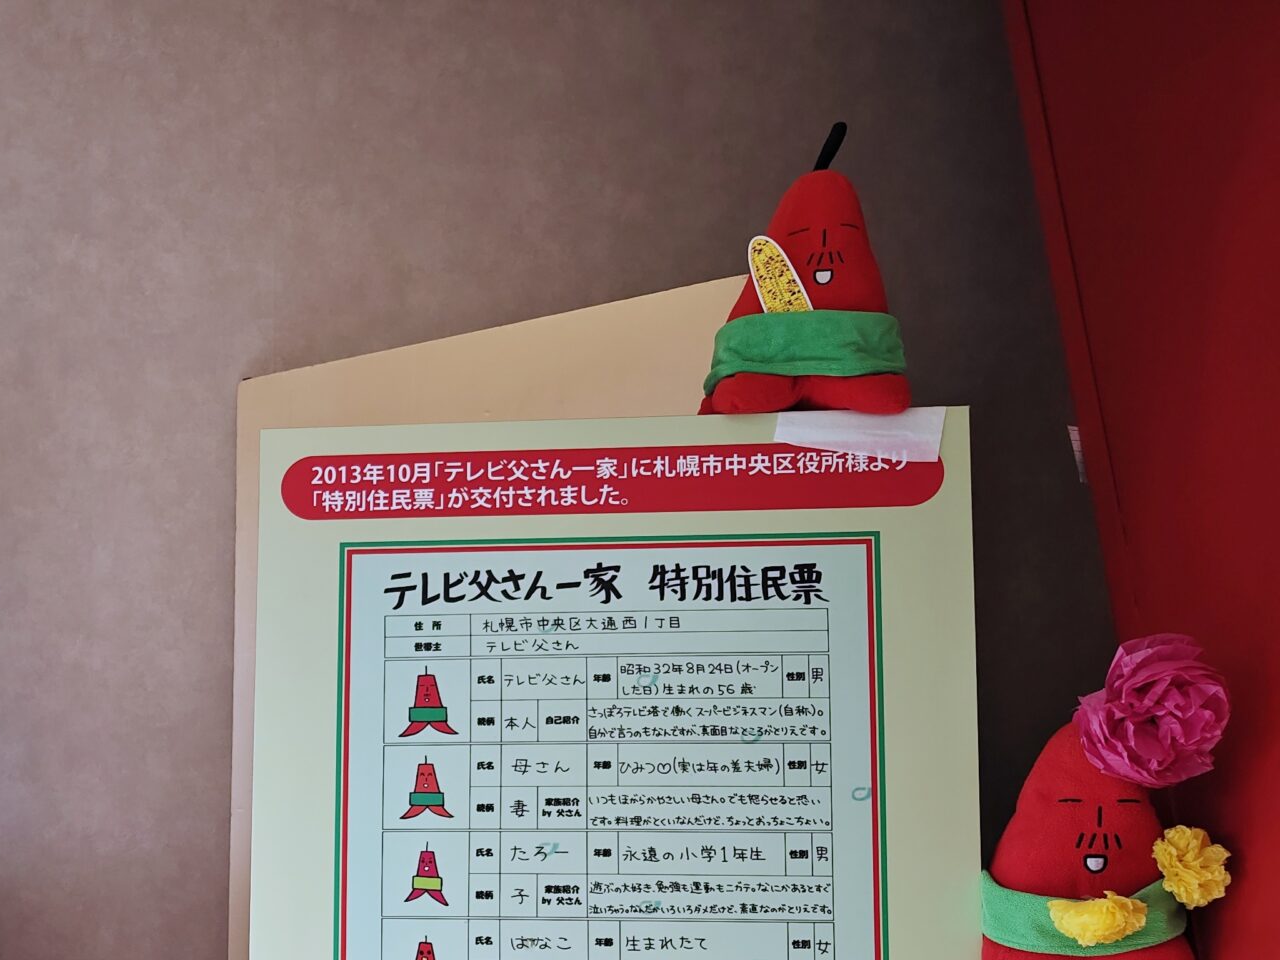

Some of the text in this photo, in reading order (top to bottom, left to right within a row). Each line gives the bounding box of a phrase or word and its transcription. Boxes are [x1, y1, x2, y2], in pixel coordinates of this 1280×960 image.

[312, 481, 629, 513] 「特別住民票」が交付されました。
[384, 562, 830, 610] テレビ父さん一家 特別住民票
[483, 616, 680, 633] 札幌市中央区大通西1丁目
[486, 638, 579, 653] テレビ父さん
[477, 675, 495, 685] 氏名
[504, 673, 586, 687] テレビ父さん
[786, 667, 824, 684] 性別 男
[505, 717, 536, 730] 本人
[545, 716, 580, 725] 自己紹介
[477, 761, 494, 771] 氏名
[512, 758, 570, 775] 母さん
[787, 760, 807, 770] 性別
[811, 758, 828, 774] 女
[509, 799, 530, 817] 妻
[476, 848, 493, 857] 氏名
[511, 845, 569, 862] たろー
[623, 845, 766, 863] 永遠の小学1年生
[789, 849, 809, 860] 性別
[816, 846, 829, 862] 男
[511, 888, 529, 905] 子
[475, 936, 493, 946] 氏名
[626, 935, 708, 952] 生まれたて
[792, 939, 811, 949] 性別
[815, 939, 831, 955] 女
